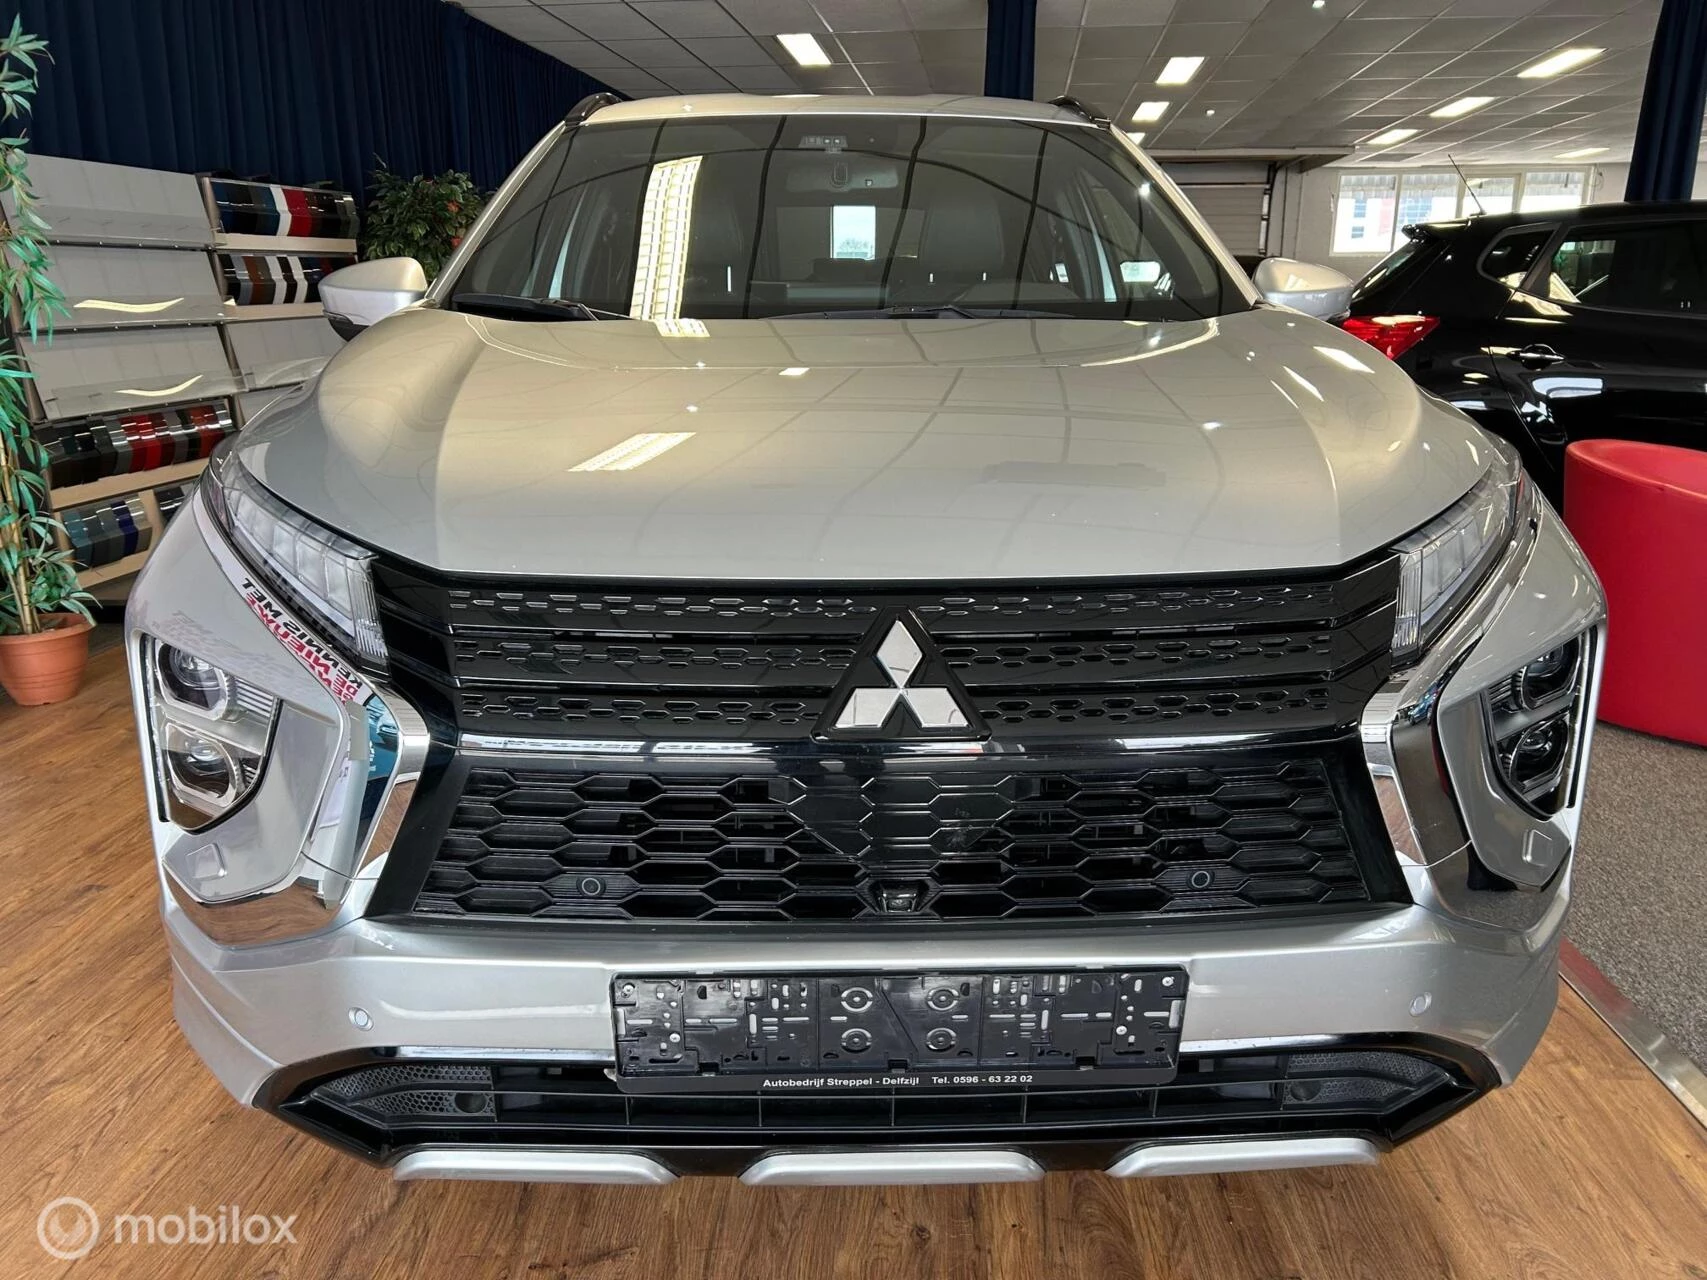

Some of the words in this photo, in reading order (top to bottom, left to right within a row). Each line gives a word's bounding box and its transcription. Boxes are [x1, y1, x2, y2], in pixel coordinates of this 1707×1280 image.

[763, 1078, 824, 1088] Autobedrijf
[826, 1077, 872, 1087] Streppel
[882, 1077, 919, 1086] Delfzijl
[932, 1076, 950, 1084] Tel.
[953, 1076, 979, 1084] 0596
[988, 1075, 1001, 1083] 63
[1004, 1075, 1017, 1083] 22
[1019, 1075, 1033, 1083] 02
